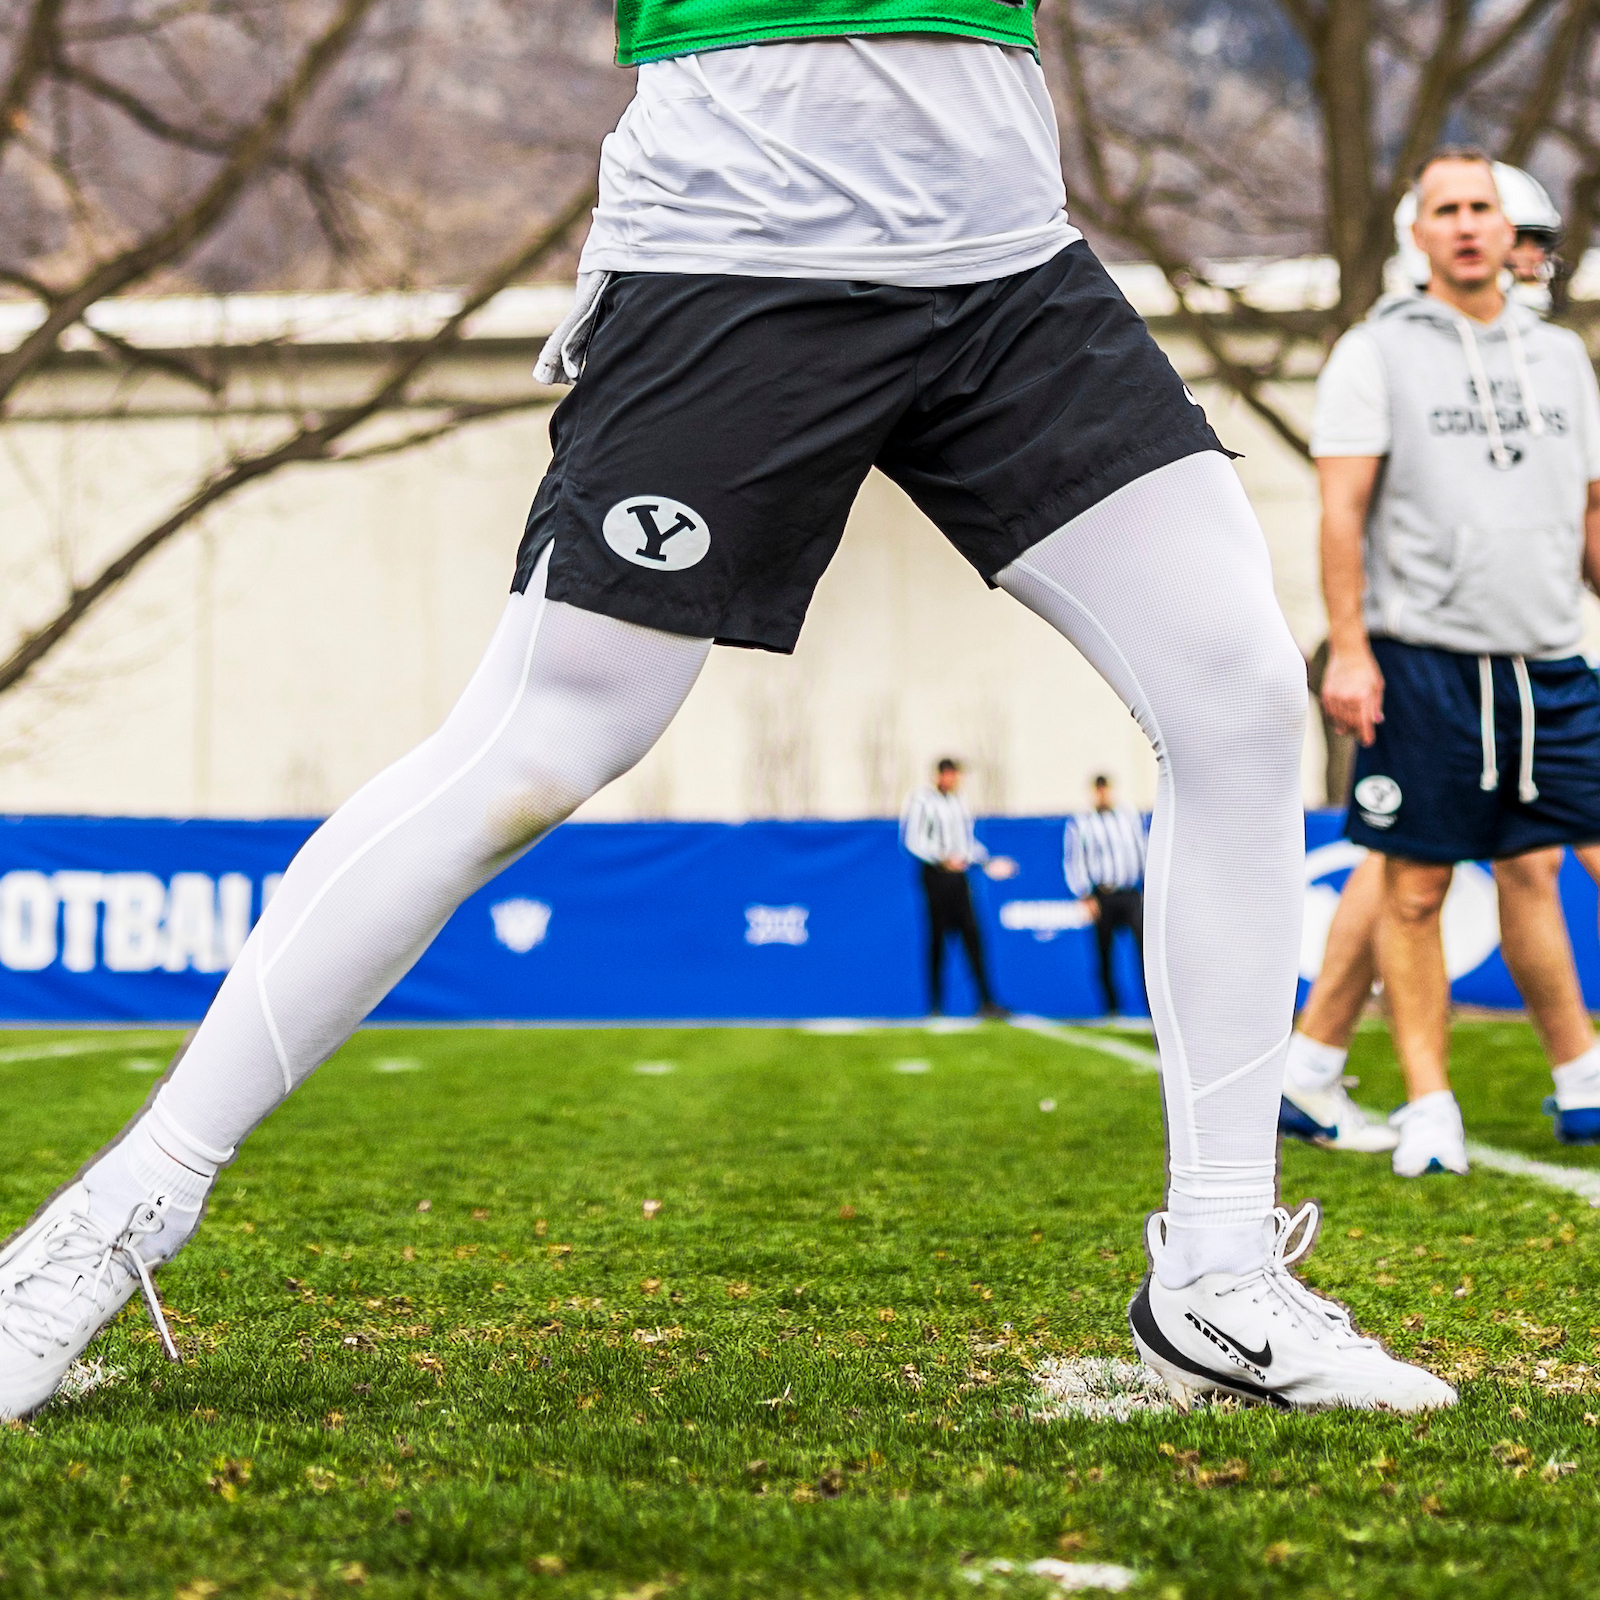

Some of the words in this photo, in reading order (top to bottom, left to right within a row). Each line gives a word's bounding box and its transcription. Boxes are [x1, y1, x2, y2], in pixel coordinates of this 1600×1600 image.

[626, 504, 697, 562] Y
[1184, 1312, 1229, 1353] AIR
[1229, 1351, 1266, 1383] ZOOM
